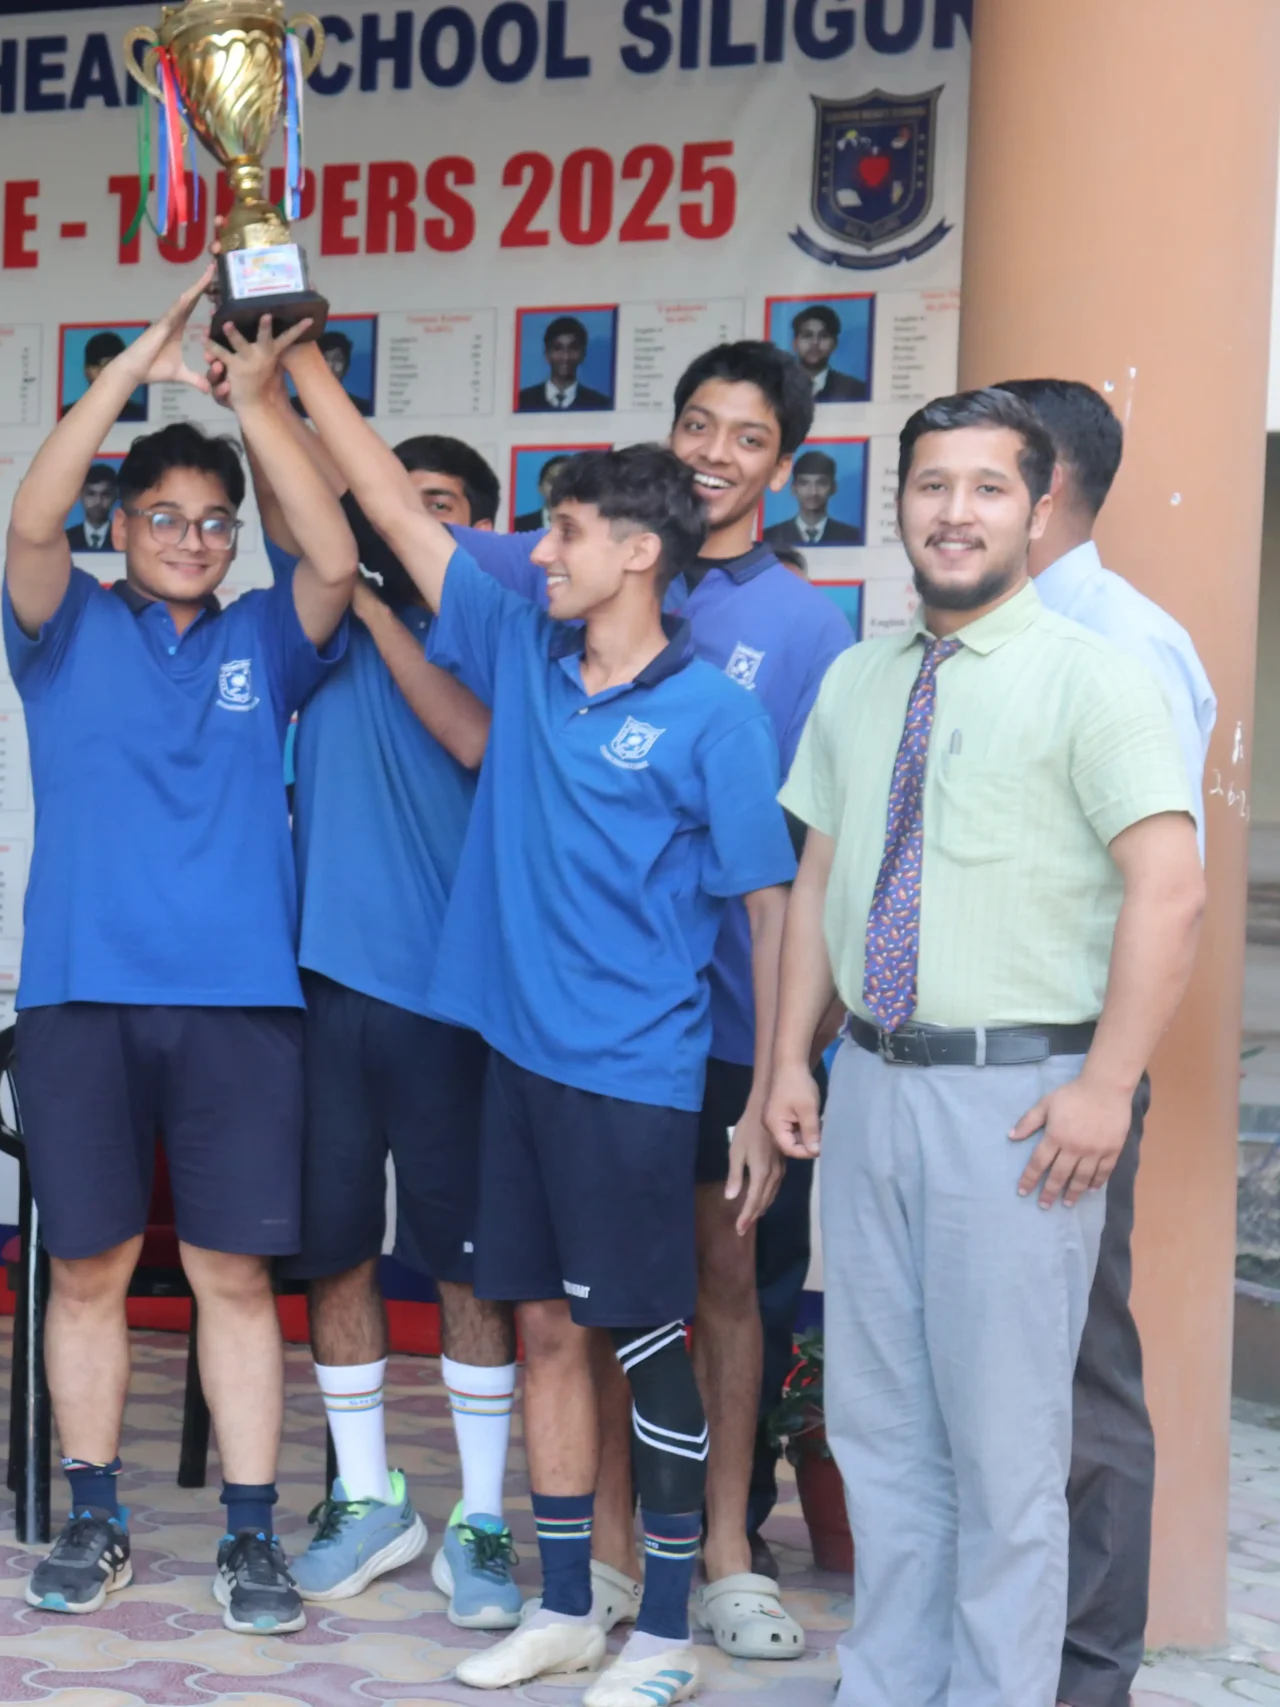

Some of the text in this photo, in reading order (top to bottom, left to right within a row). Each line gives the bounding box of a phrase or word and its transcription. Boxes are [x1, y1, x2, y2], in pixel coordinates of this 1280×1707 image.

[306, 0, 590, 96] CHOOL
[61, 222, 87, 238] -
[501, 141, 737, 248] 2025
